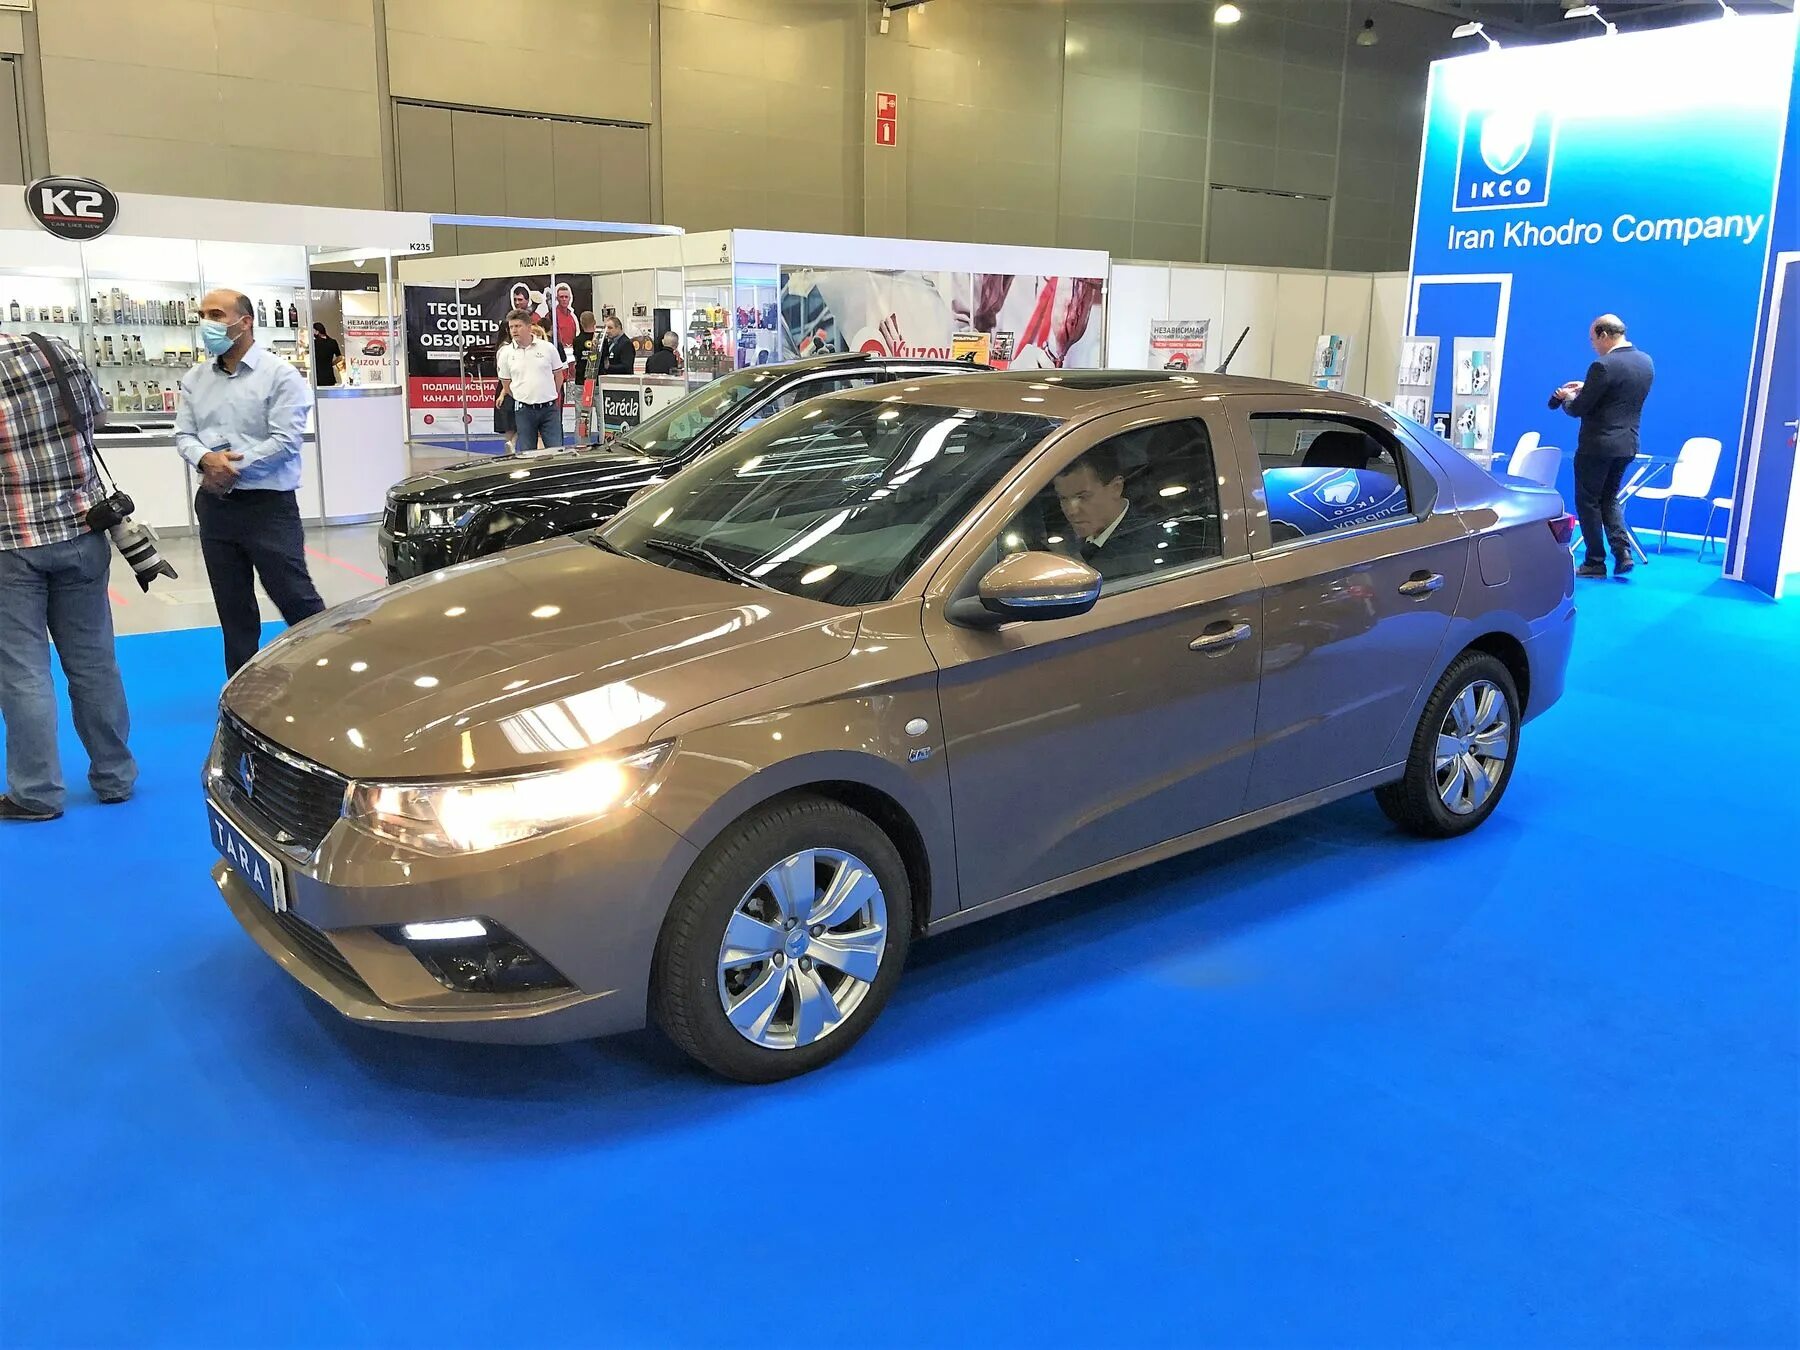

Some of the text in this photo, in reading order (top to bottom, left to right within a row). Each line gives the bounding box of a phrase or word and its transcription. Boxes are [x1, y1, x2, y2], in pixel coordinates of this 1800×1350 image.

[1470, 178, 1531, 199] IKCO
[41, 188, 104, 218] K2
[1448, 213, 1765, 251] Iran Khodro Company
[409, 243, 431, 251] K235
[519, 256, 549, 268] KUZOV LAB
[427, 302, 481, 316] ТЕСТЫ
[420, 333, 490, 347] ОБЗОРЫ
[483, 383, 496, 391] НА
[604, 396, 639, 417] Farécla
[215, 819, 265, 891] TARA
